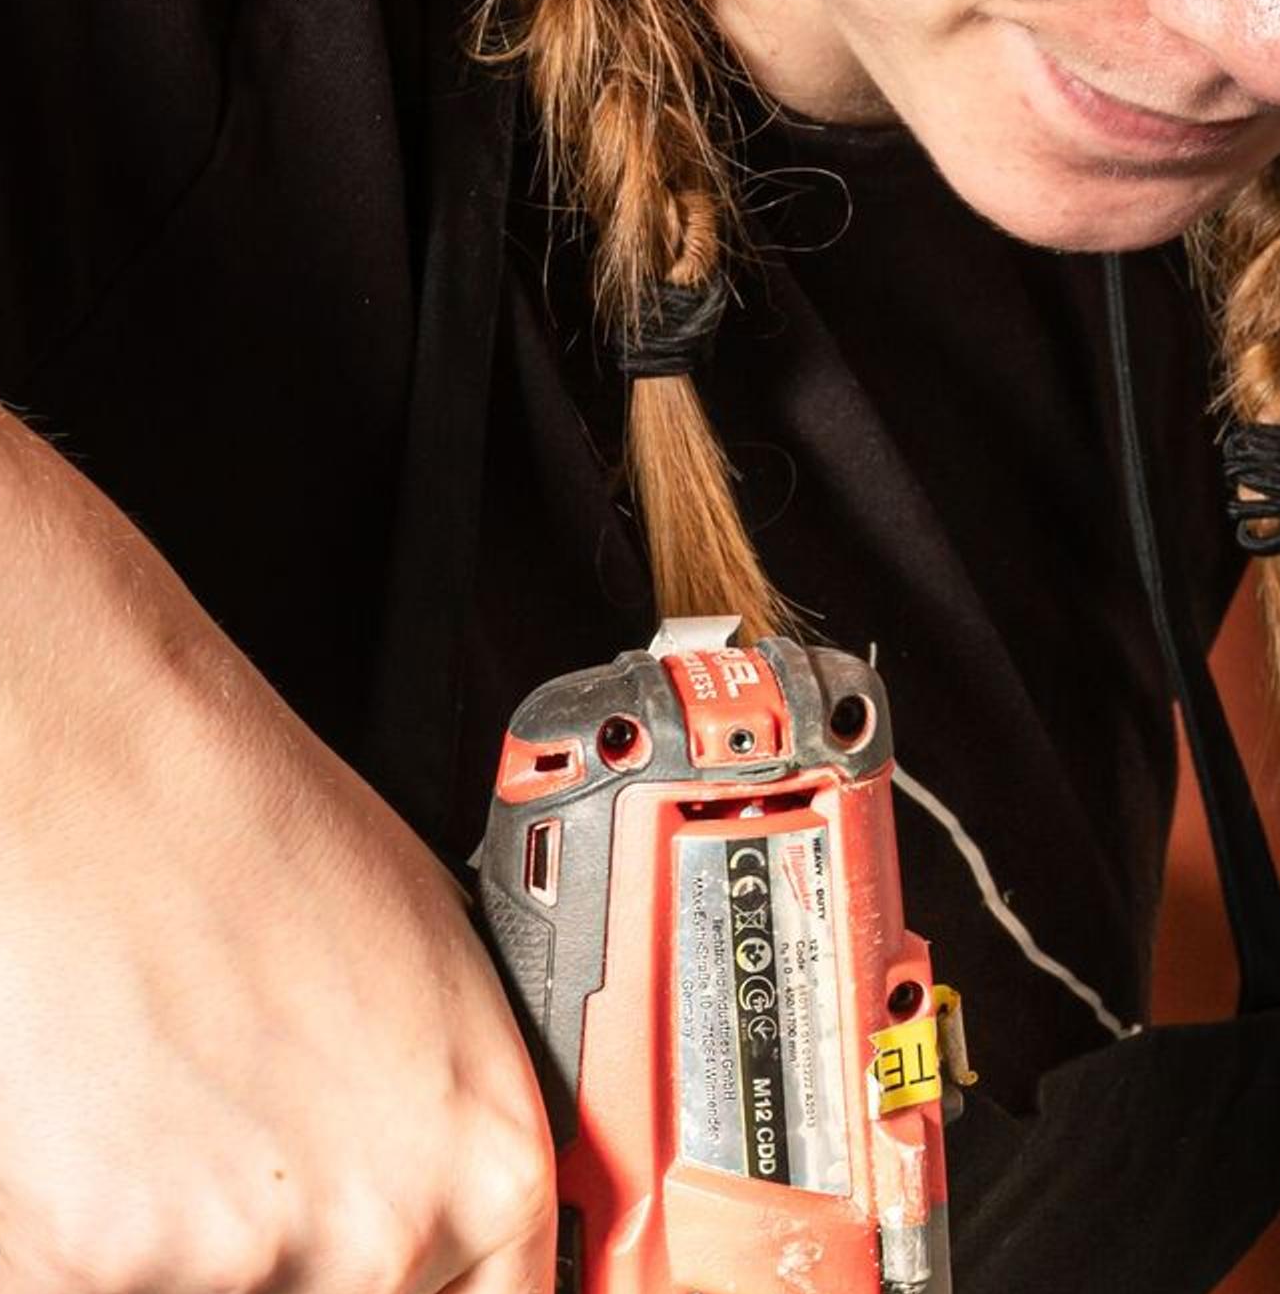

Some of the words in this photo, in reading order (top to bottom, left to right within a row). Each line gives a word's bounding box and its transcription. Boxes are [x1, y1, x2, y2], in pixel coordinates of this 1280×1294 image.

[813, 837, 823, 875] HEAVY
[816, 888, 826, 920] DUTY
[874, 1043, 935, 1092] TE
[751, 1077, 776, 1123] M12
[755, 1126, 779, 1175] CDD
